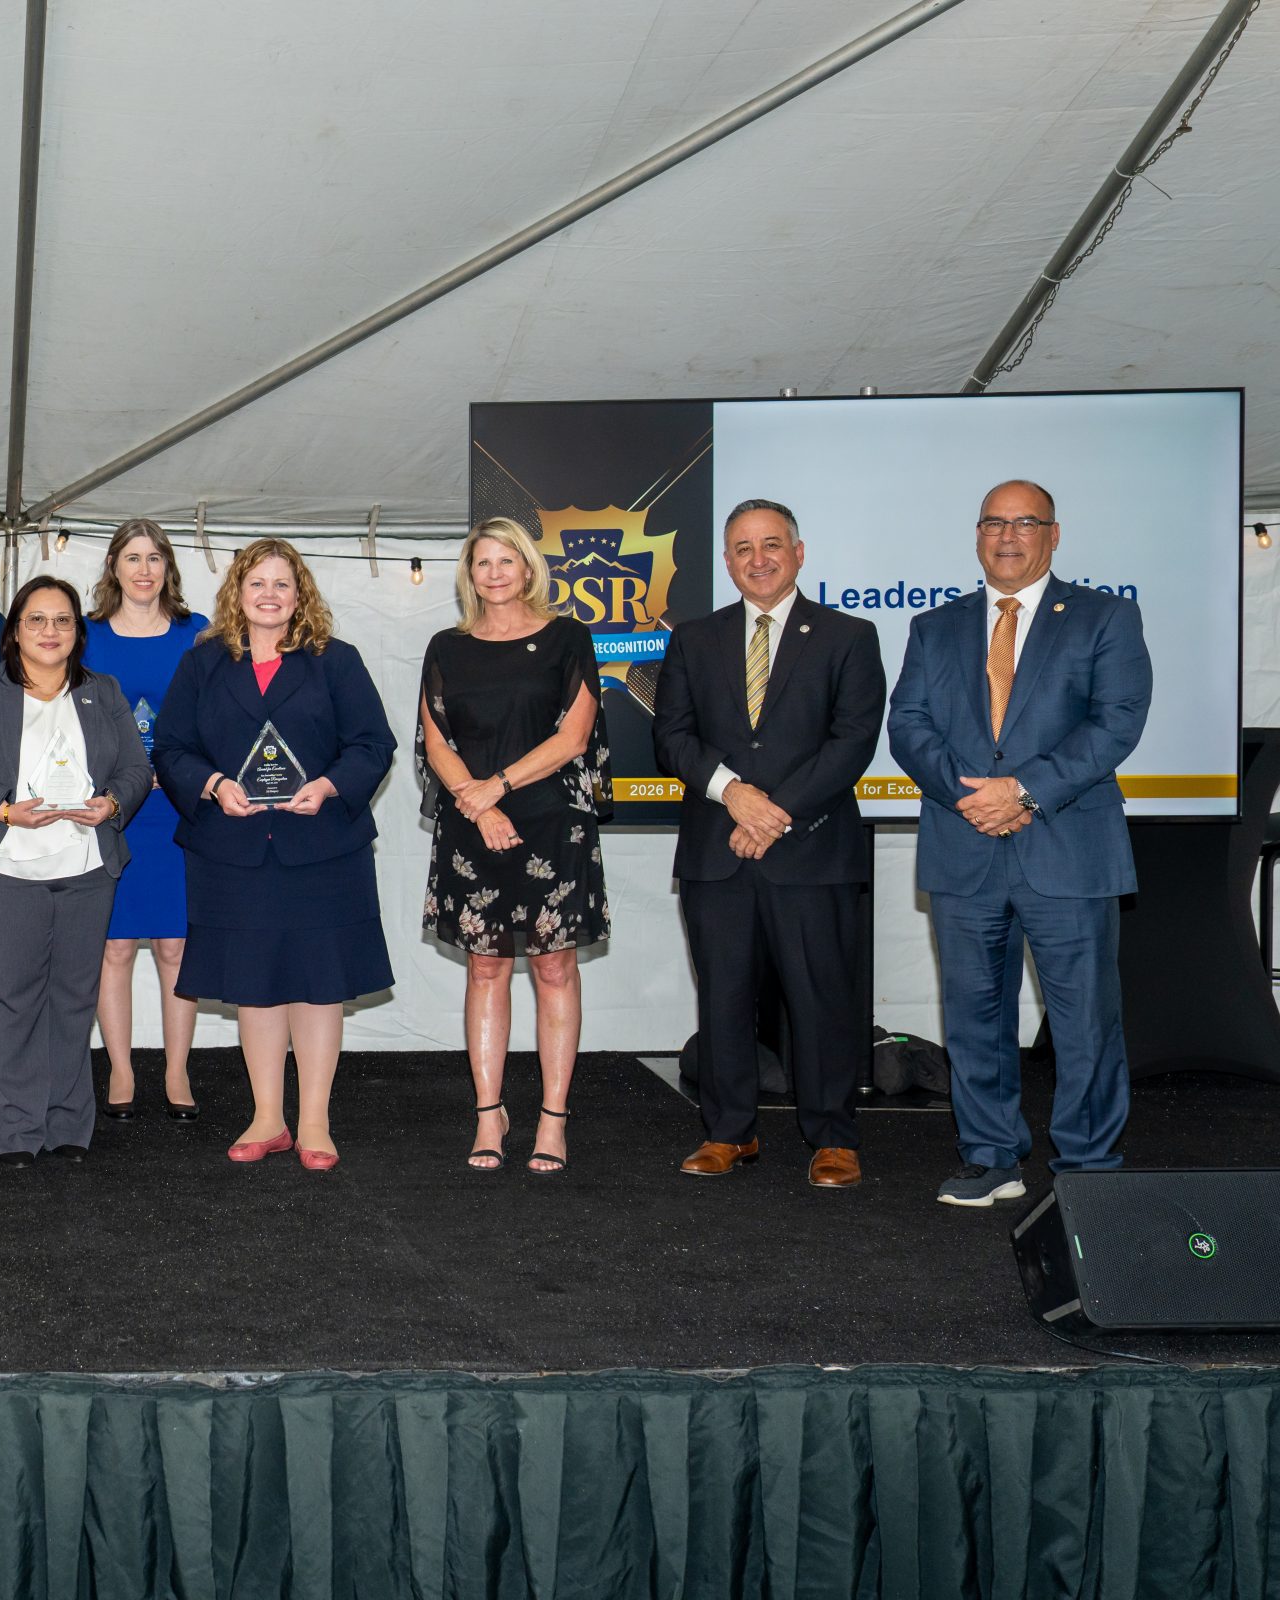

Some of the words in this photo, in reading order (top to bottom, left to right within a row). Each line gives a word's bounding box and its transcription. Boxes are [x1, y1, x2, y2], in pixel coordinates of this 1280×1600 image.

[819, 581, 962, 609] Leaders
[593, 639, 665, 654] RECOGNITION
[630, 784, 664, 796] 2026
[863, 783, 882, 795] for
